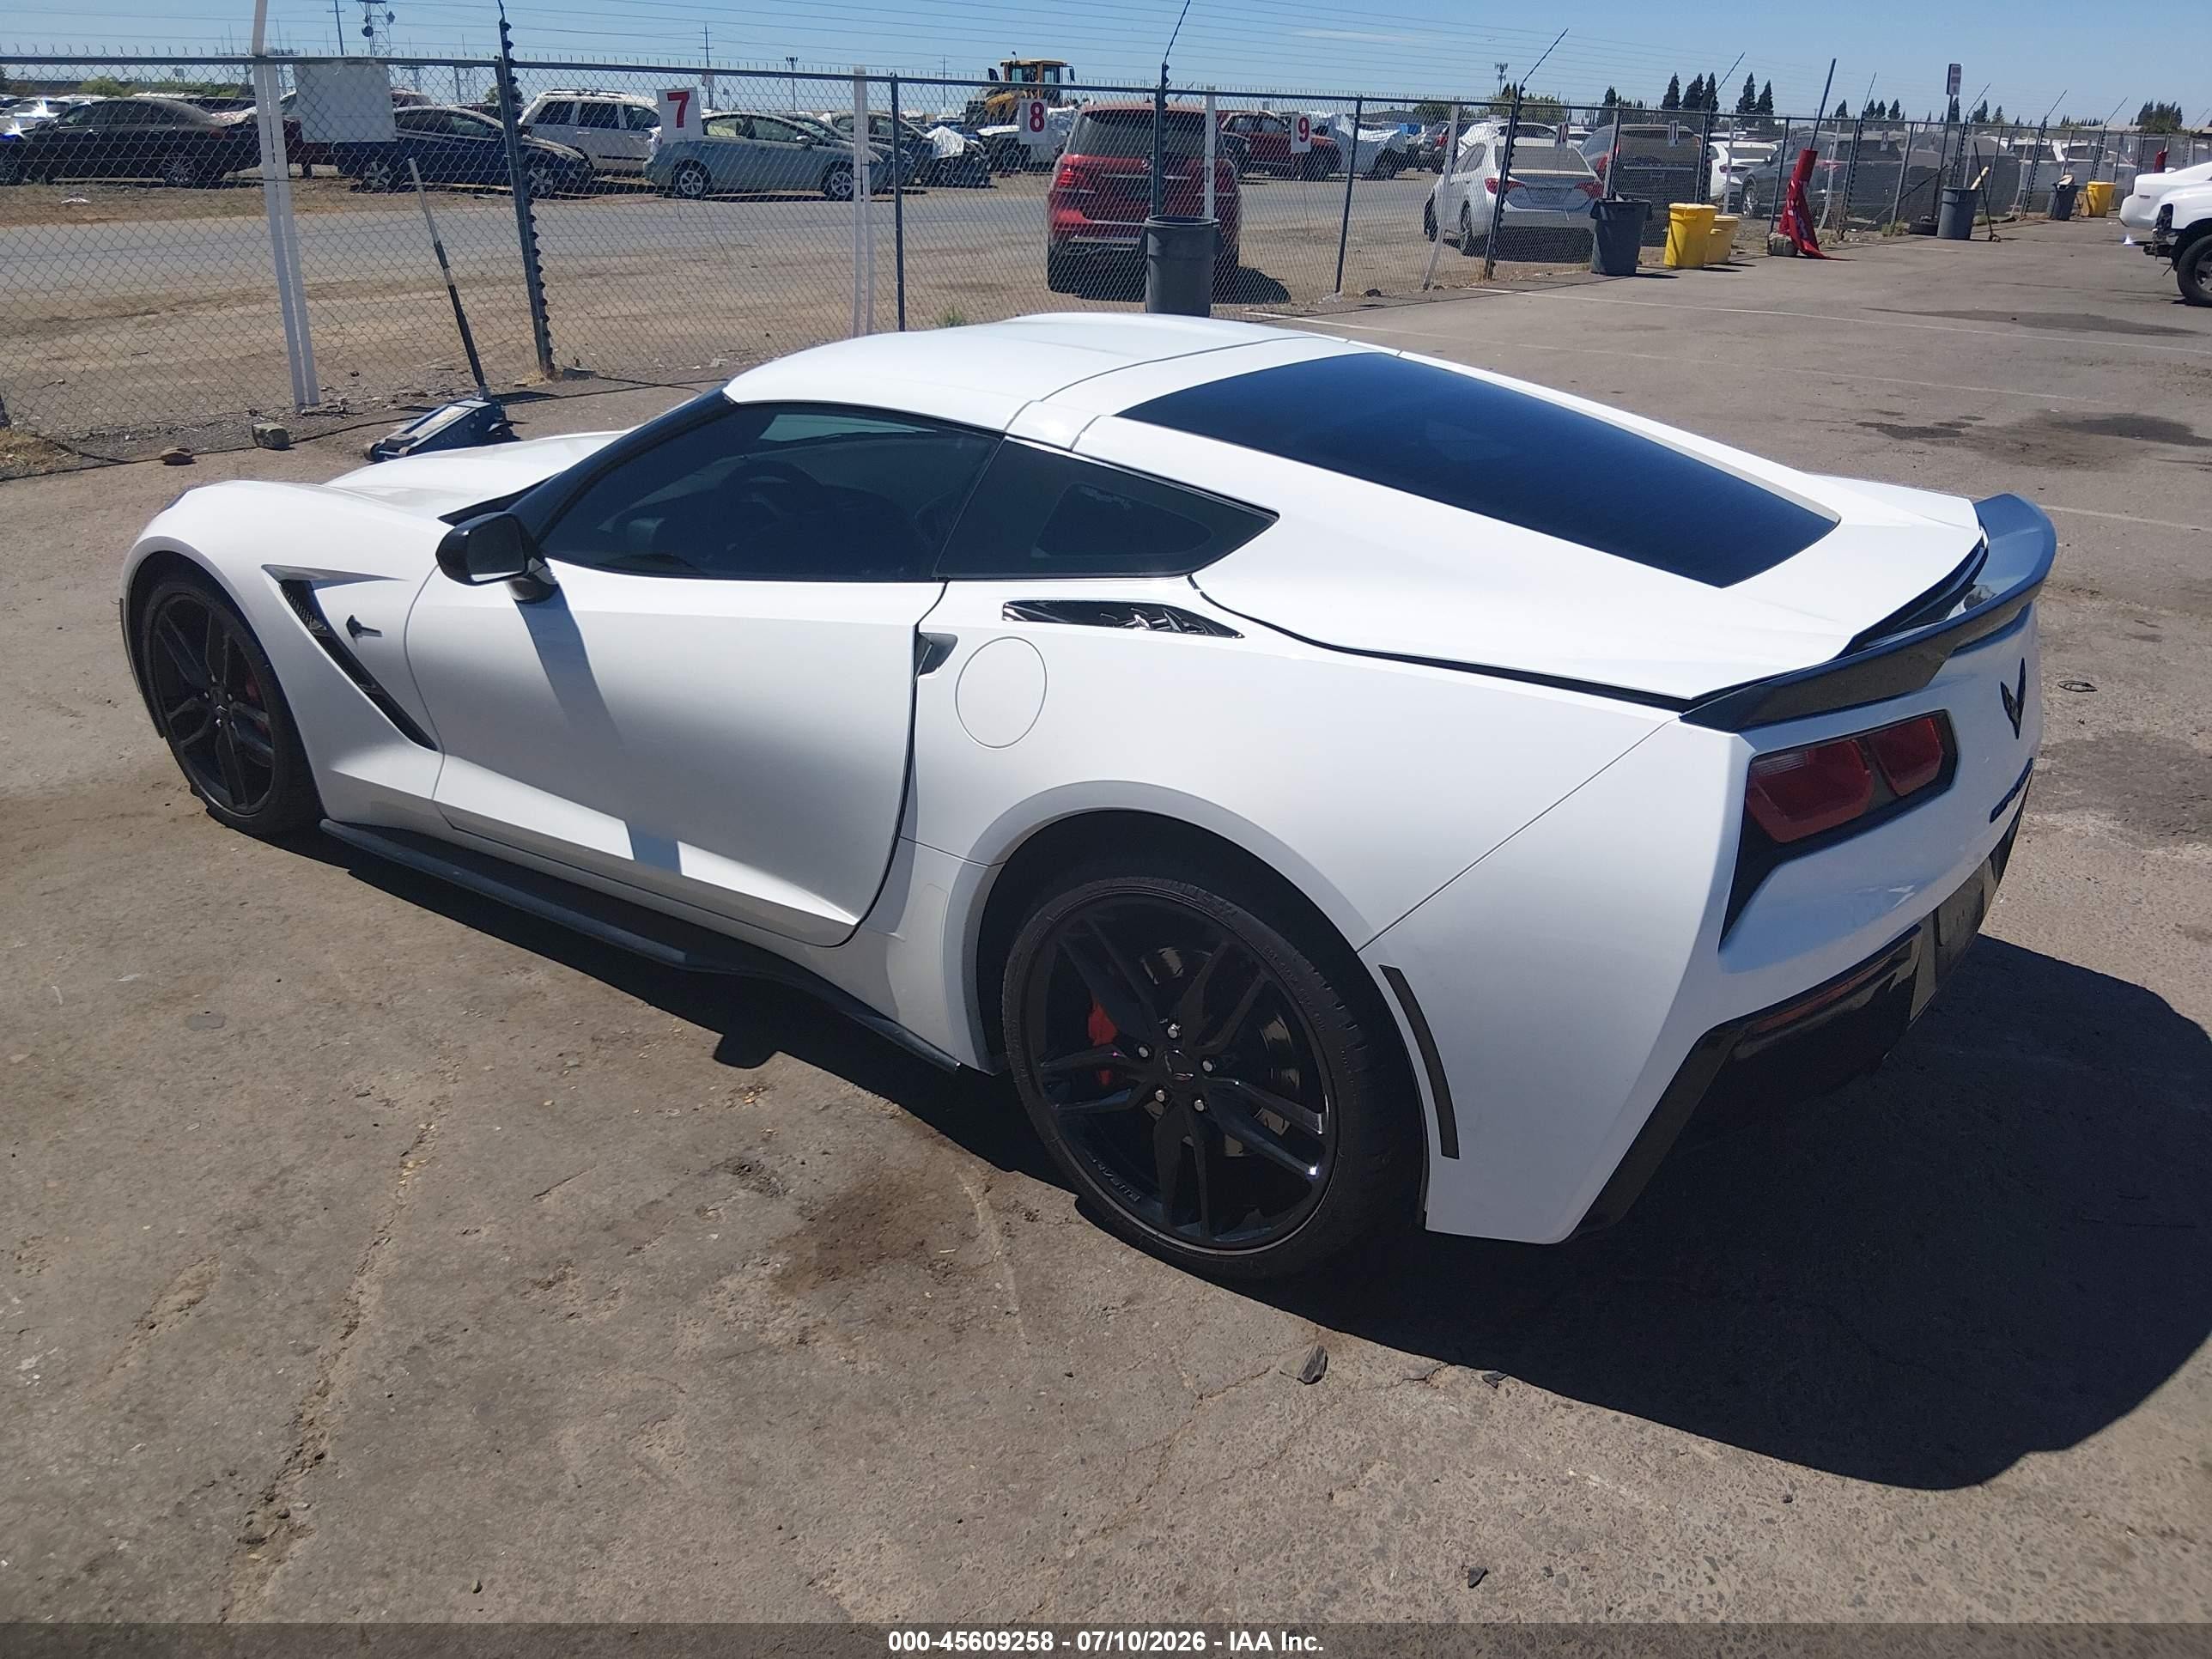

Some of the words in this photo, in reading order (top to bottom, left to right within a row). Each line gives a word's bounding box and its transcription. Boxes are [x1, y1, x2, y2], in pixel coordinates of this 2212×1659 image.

[666, 91, 690, 129] 7
[1030, 101, 1045, 132] 8
[1297, 117, 1310, 143] 9
[1558, 123, 1569, 144] 10
